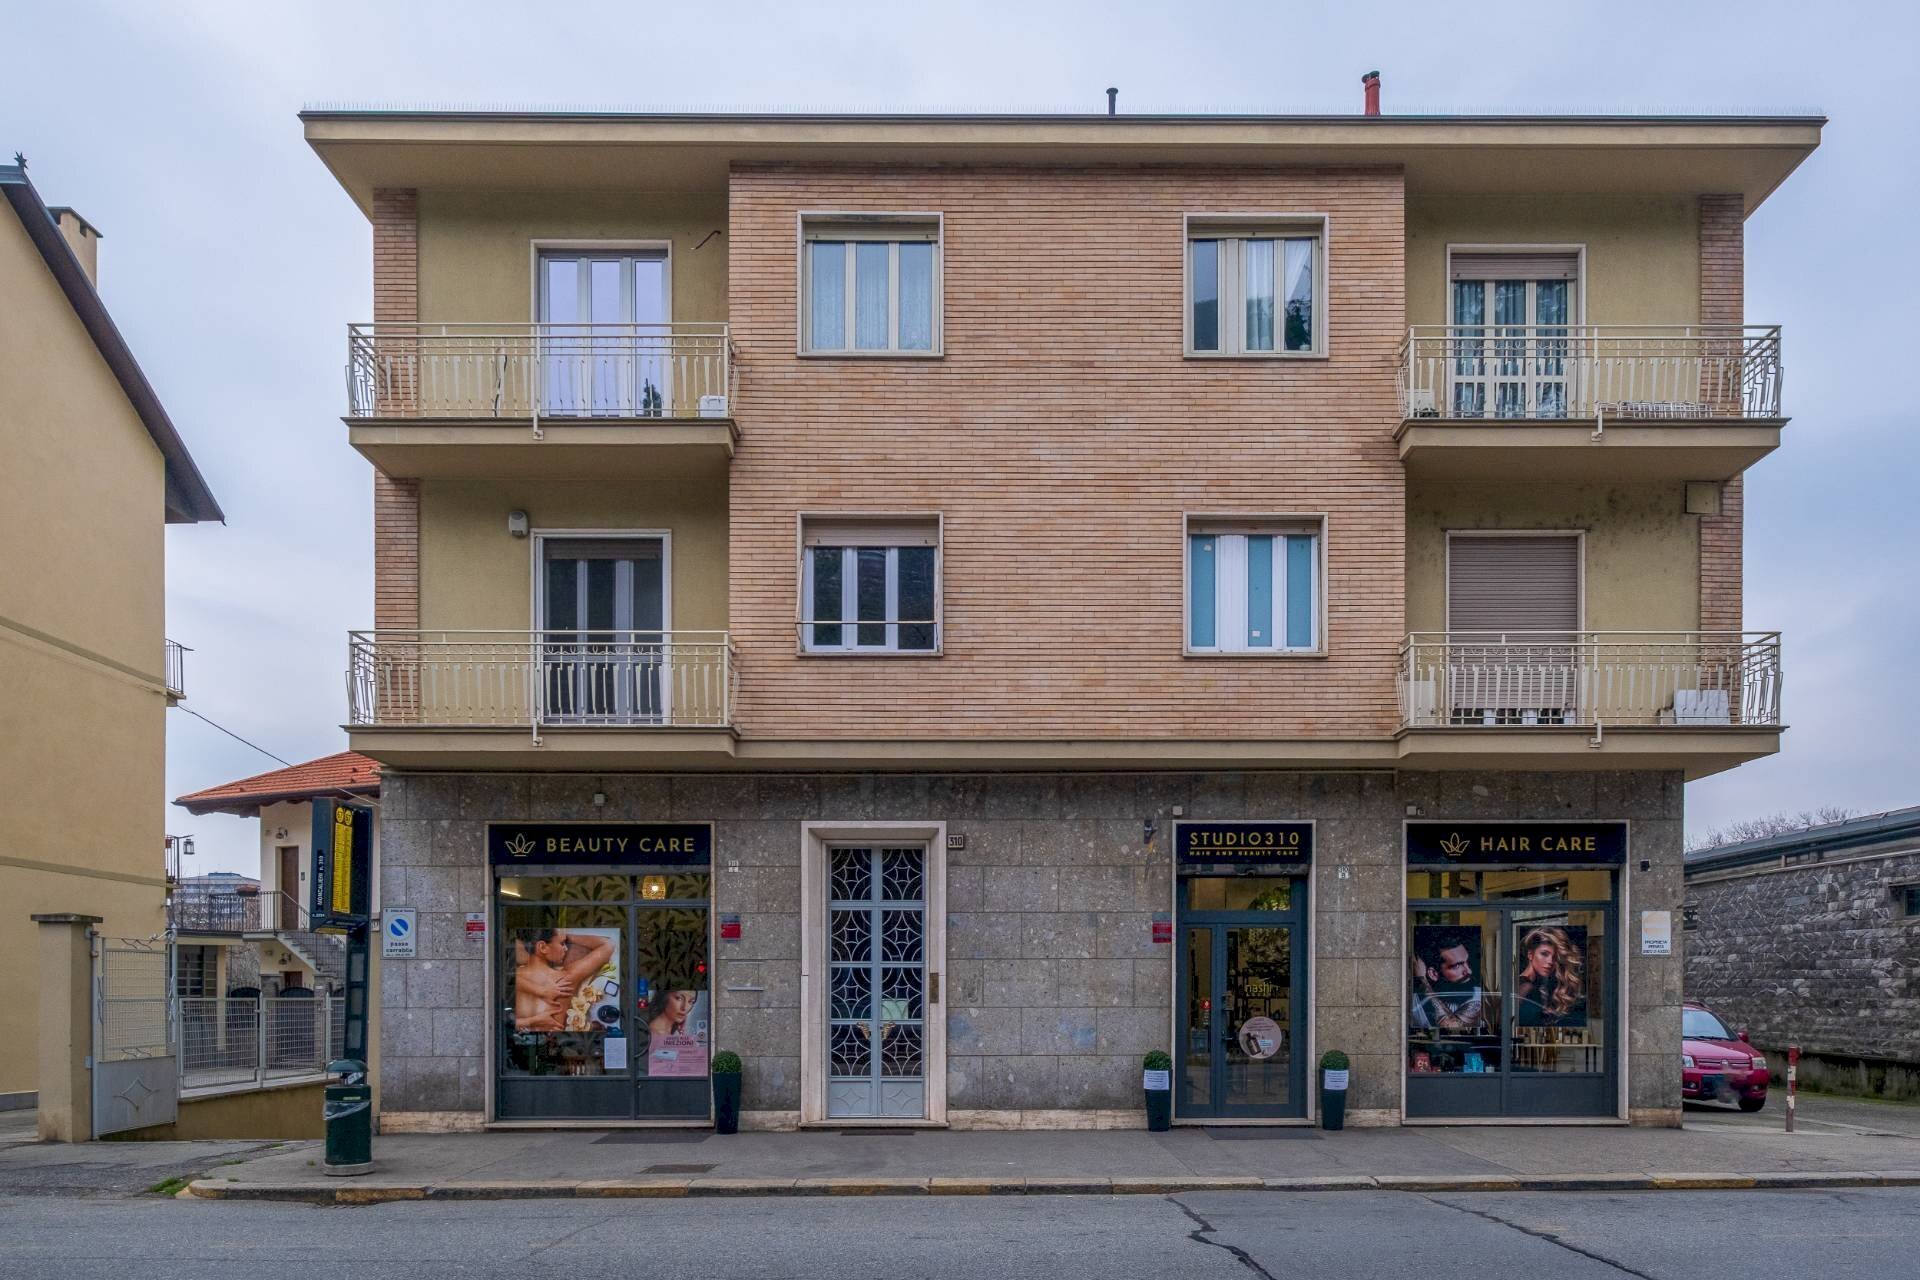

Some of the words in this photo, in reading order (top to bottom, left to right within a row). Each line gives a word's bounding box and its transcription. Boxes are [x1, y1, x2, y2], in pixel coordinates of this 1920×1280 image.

[546, 837, 629, 852] BEAUTY
[639, 837, 695, 852] CARE
[949, 836, 963, 846] 310
[1190, 832, 1299, 845] STUDIO310
[1480, 837, 1530, 851] HAIR
[1541, 837, 1596, 851] CARE
[1245, 981, 1272, 993] nashi
